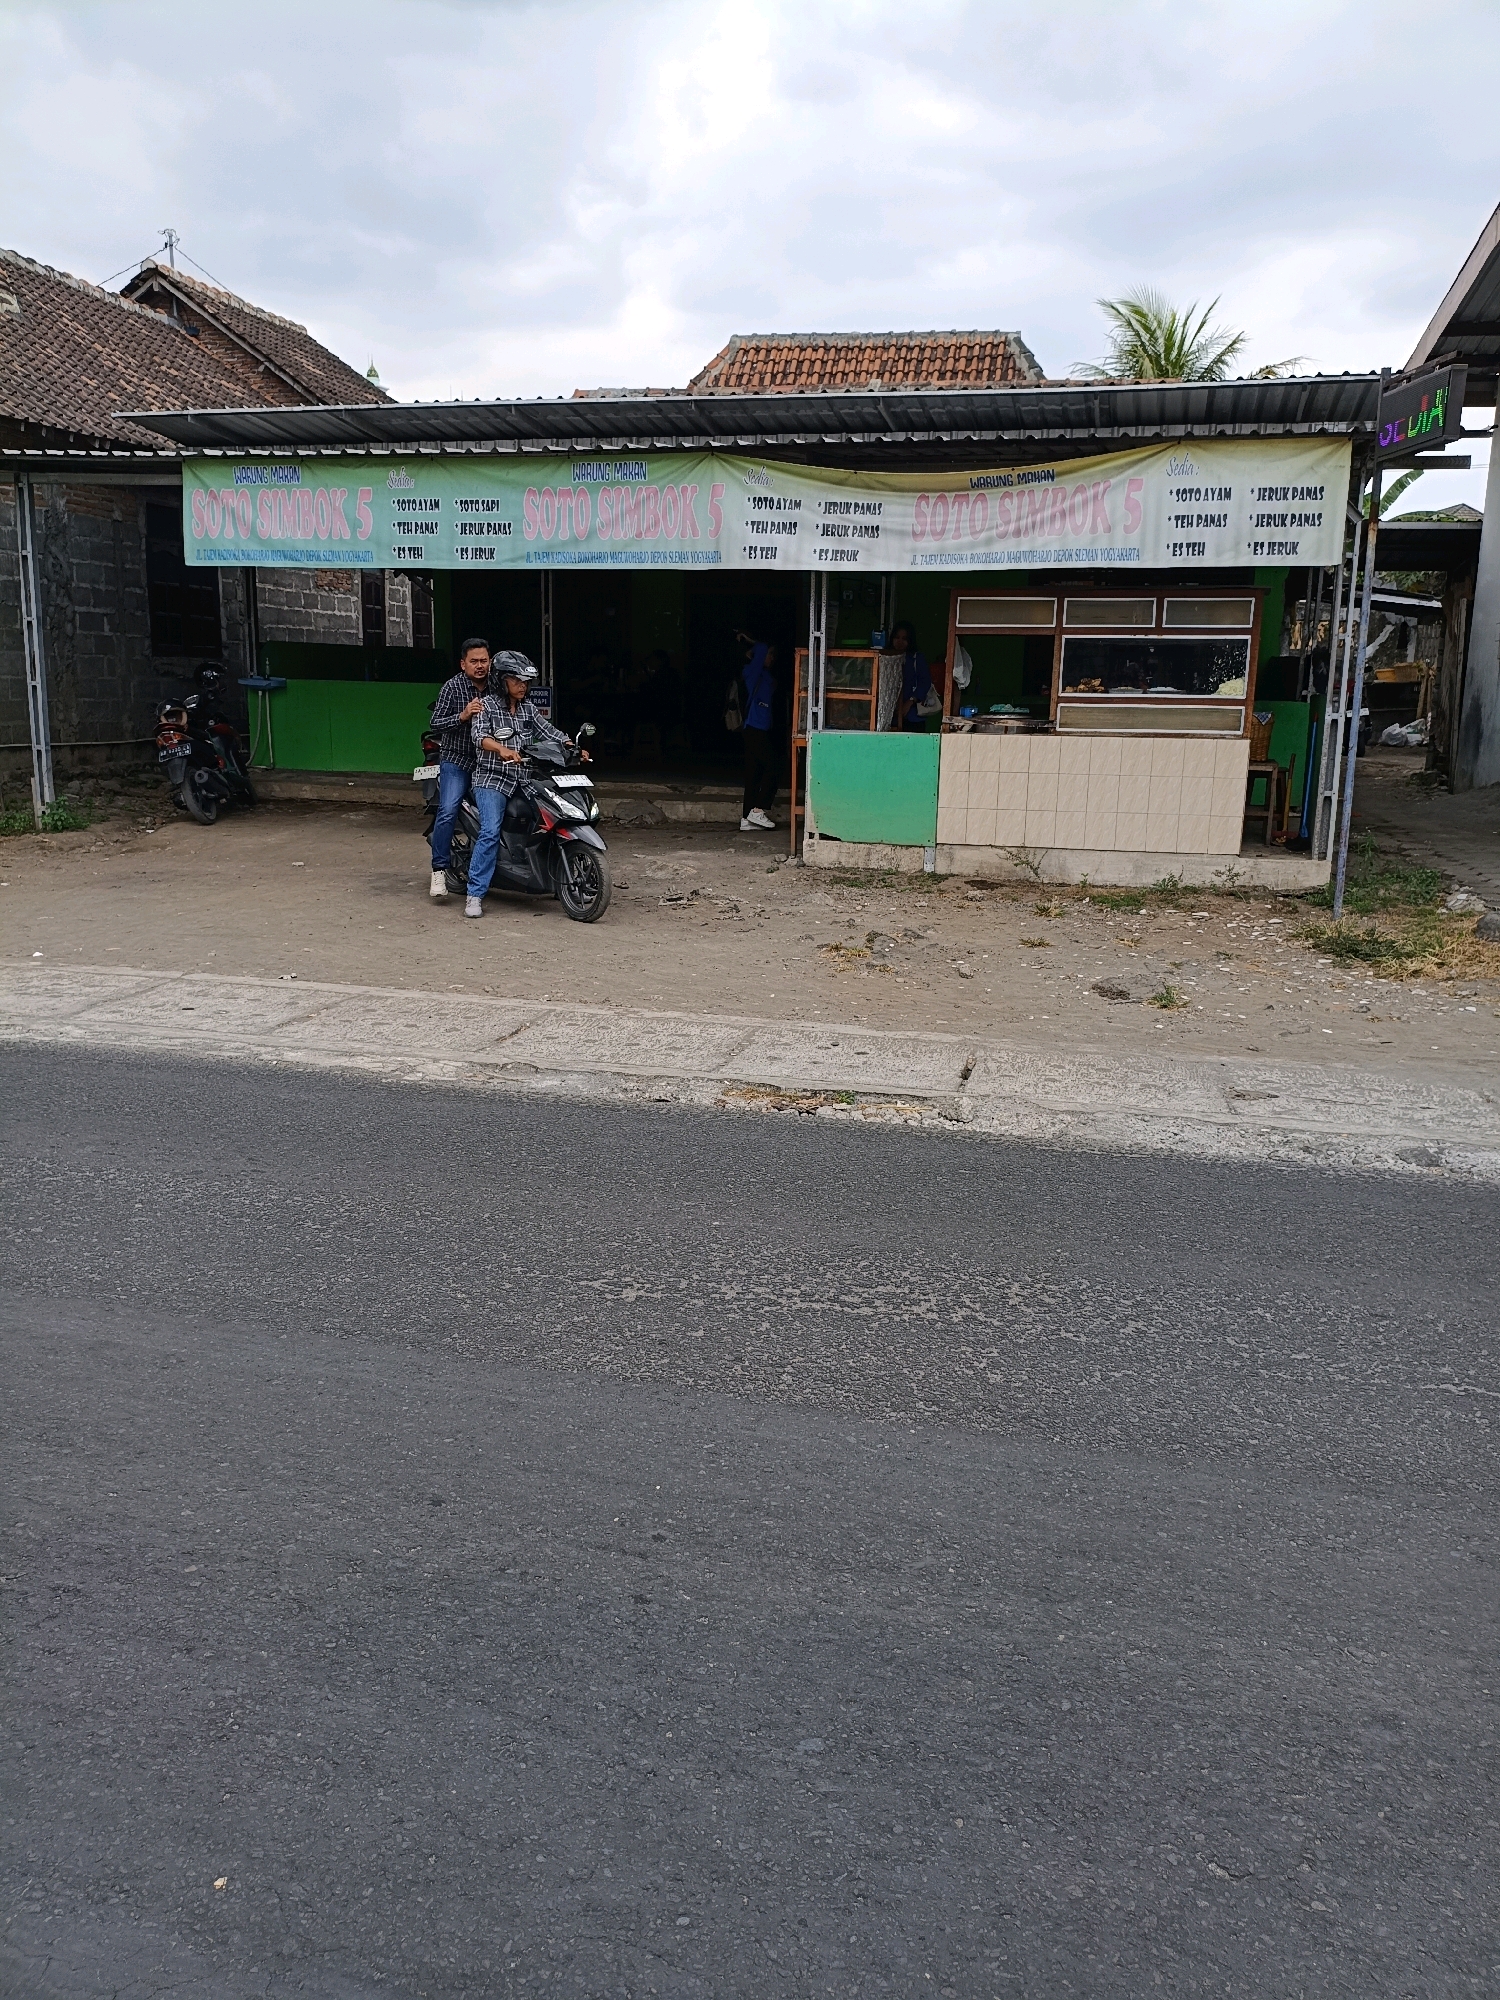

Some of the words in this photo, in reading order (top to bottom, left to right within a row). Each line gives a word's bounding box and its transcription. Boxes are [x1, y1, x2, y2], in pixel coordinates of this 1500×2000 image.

[234, 466, 268, 485] WARUNG
[271, 466, 302, 484] MAKAN
[572, 462, 611, 483] WARUNG
[613, 460, 648, 482] MAKAN
[970, 474, 1014, 489] WARUNG
[1017, 469, 1055, 485] MAKAN
[1175, 487, 1201, 502] SOTO
[1203, 487, 1232, 502] AYAM
[1256, 487, 1290, 502] JERUK
[1291, 486, 1325, 501] PANAS
[397, 498, 417, 512] SOTO
[418, 498, 440, 512] AYAM
[460, 499, 480, 512] SOTO
[481, 499, 500, 512] SAPI
[523, 485, 591, 540] SOTO
[597, 484, 700, 540] SIMBOK
[708, 483, 725, 540] 5
[752, 497, 774, 511] SOTO
[775, 498, 802, 511] AYAM
[823, 501, 852, 515] JERUK
[853, 502, 882, 516] PANAS
[911, 492, 991, 543] SOTO
[995, 480, 1112, 540] SIMBOK
[1122, 478, 1145, 536] 5
[192, 489, 252, 540] SOTO
[257, 488, 351, 540] SIMBOK
[357, 487, 373, 540] 5
[1174, 514, 1194, 529] TEH
[1195, 513, 1228, 528] PANAS
[1254, 513, 1288, 528] JERUK
[1289, 512, 1323, 528] PANAS
[397, 522, 413, 535] TEH
[414, 522, 438, 535] PANAS
[460, 522, 485, 536] JERUK
[487, 523, 512, 536] PANAS
[750, 521, 768, 534] TEH
[769, 521, 797, 535] PANAS
[821, 523, 850, 537] JERUK
[851, 525, 880, 539] PANAS
[397, 546, 406, 559] ES
[408, 546, 423, 560] TEH
[460, 547, 469, 560] ES
[470, 547, 496, 561] JERUK
[748, 546, 757, 559] ES
[759, 546, 777, 560] TEH
[818, 549, 828, 561] ES
[829, 549, 859, 562] JERUK
[1053, 550, 1074, 563] DEPOK
[1074, 548, 1099, 563] SLEMAN
[1100, 547, 1140, 562] YOGYAKARTA
[1172, 542, 1184, 557] ES
[1185, 541, 1205, 556] TEH
[1253, 541, 1265, 556] ES
[1266, 541, 1299, 556] JERUK
[342, 550, 374, 563] YOGYAKARTA
[669, 551, 690, 564] SLEMAN
[690, 551, 722, 564] YOGYAKARTA
